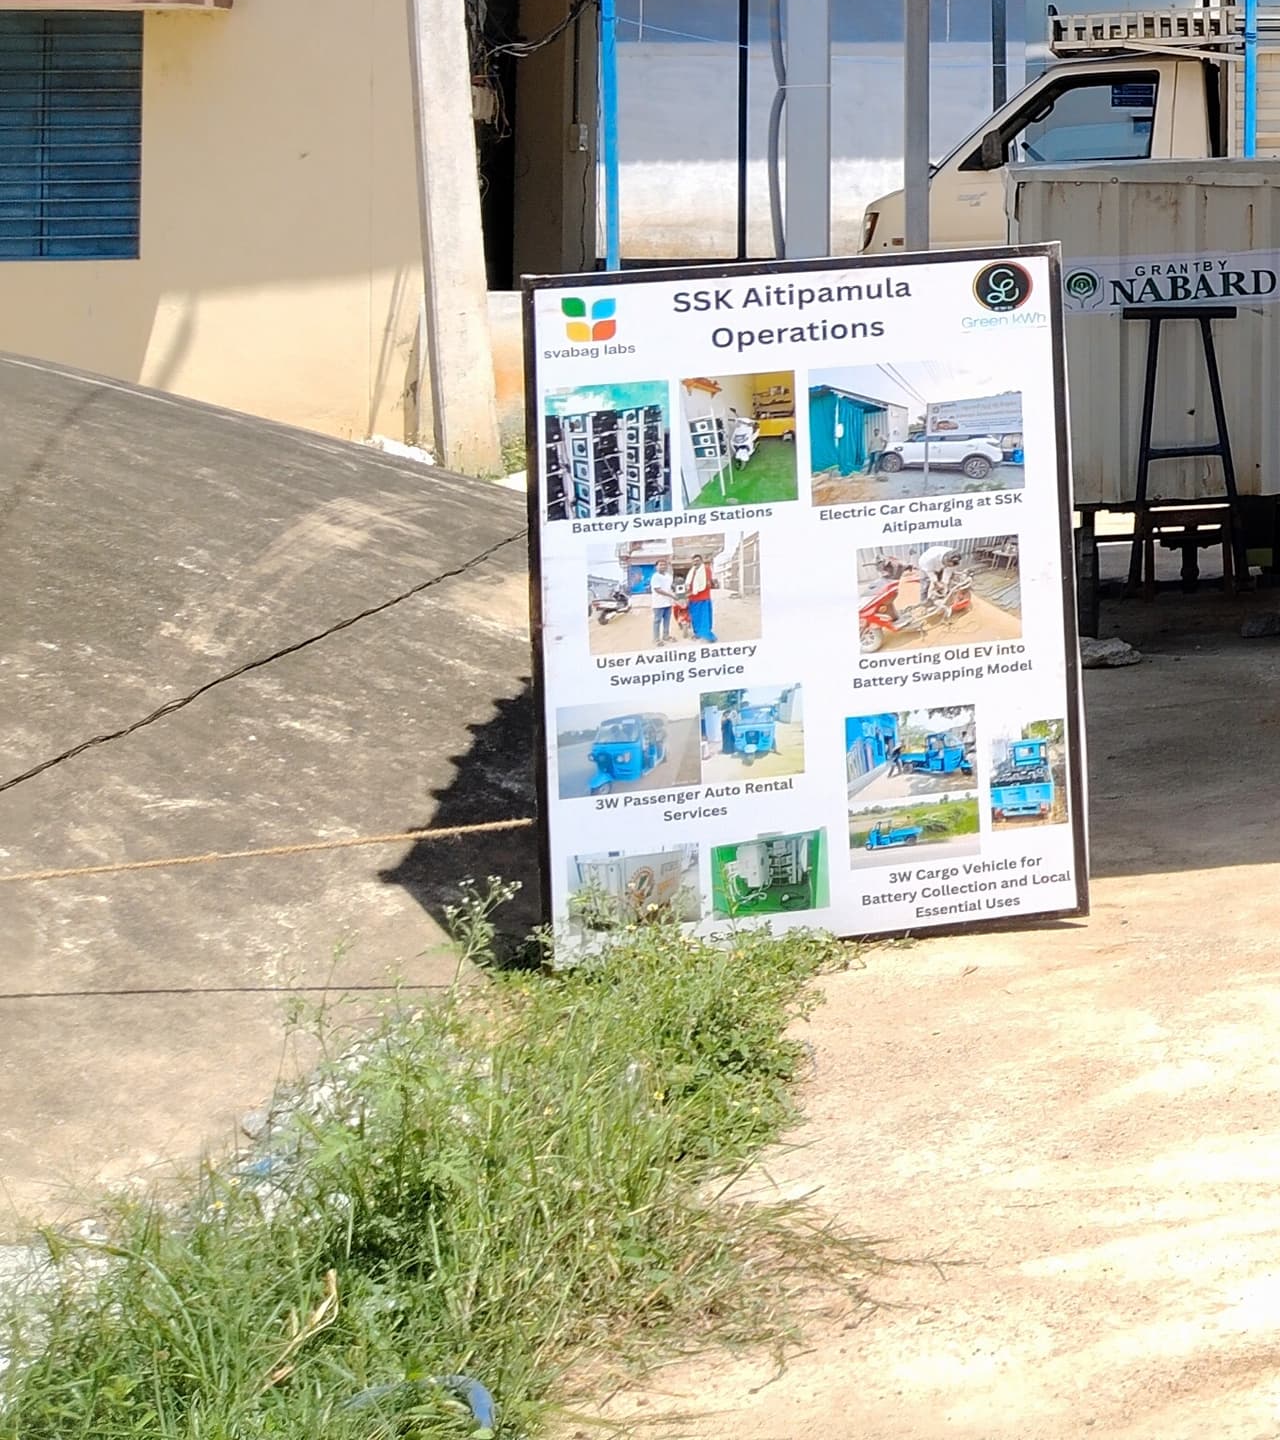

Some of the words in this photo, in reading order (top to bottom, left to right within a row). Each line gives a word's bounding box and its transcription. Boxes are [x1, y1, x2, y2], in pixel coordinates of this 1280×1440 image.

[673, 289, 733, 312] SSK
[742, 277, 912, 310] Aitipamula
[1110, 269, 1277, 306] NABARD
[961, 313, 1008, 328] Green
[1012, 312, 1047, 325] kWh
[712, 319, 885, 352] Operations
[544, 346, 599, 359] svabag
[604, 343, 636, 355] labs
[820, 506, 876, 521] Electric
[880, 504, 905, 516] Car
[908, 497, 973, 513] Charging
[977, 495, 991, 506] at
[995, 492, 1023, 505] SSK
[572, 520, 629, 534] Battery
[633, 512, 706, 529] Swapping
[710, 507, 773, 522] Stations
[882, 517, 962, 534] Aitipamula
[596, 657, 631, 668] User
[635, 650, 697, 666] Availing
[700, 644, 757, 659] Battery
[858, 652, 941, 670] Converting
[944, 647, 970, 661] Old
[974, 646, 993, 658] EV
[996, 644, 1026, 656] into
[610, 670, 684, 686] Swapping
[688, 663, 744, 678] Service
[853, 675, 908, 689] Battery
[912, 666, 984, 682] Swapping
[987, 659, 1033, 675] Model
[595, 798, 619, 810] 3W
[624, 790, 700, 807] Passenger
[704, 785, 740, 799] Auto
[745, 778, 794, 794] Rental
[663, 806, 728, 822] Services
[889, 871, 912, 884] 3W
[916, 867, 959, 881] Cargo
[963, 858, 1017, 875] Vehicle
[1020, 856, 1042, 867] for
[862, 891, 917, 906] Battery
[921, 880, 997, 899] Collection
[1001, 873, 1028, 887] and
[1032, 870, 1071, 885] Local
[915, 900, 981, 918] Essential
[985, 895, 1021, 910] Uses
